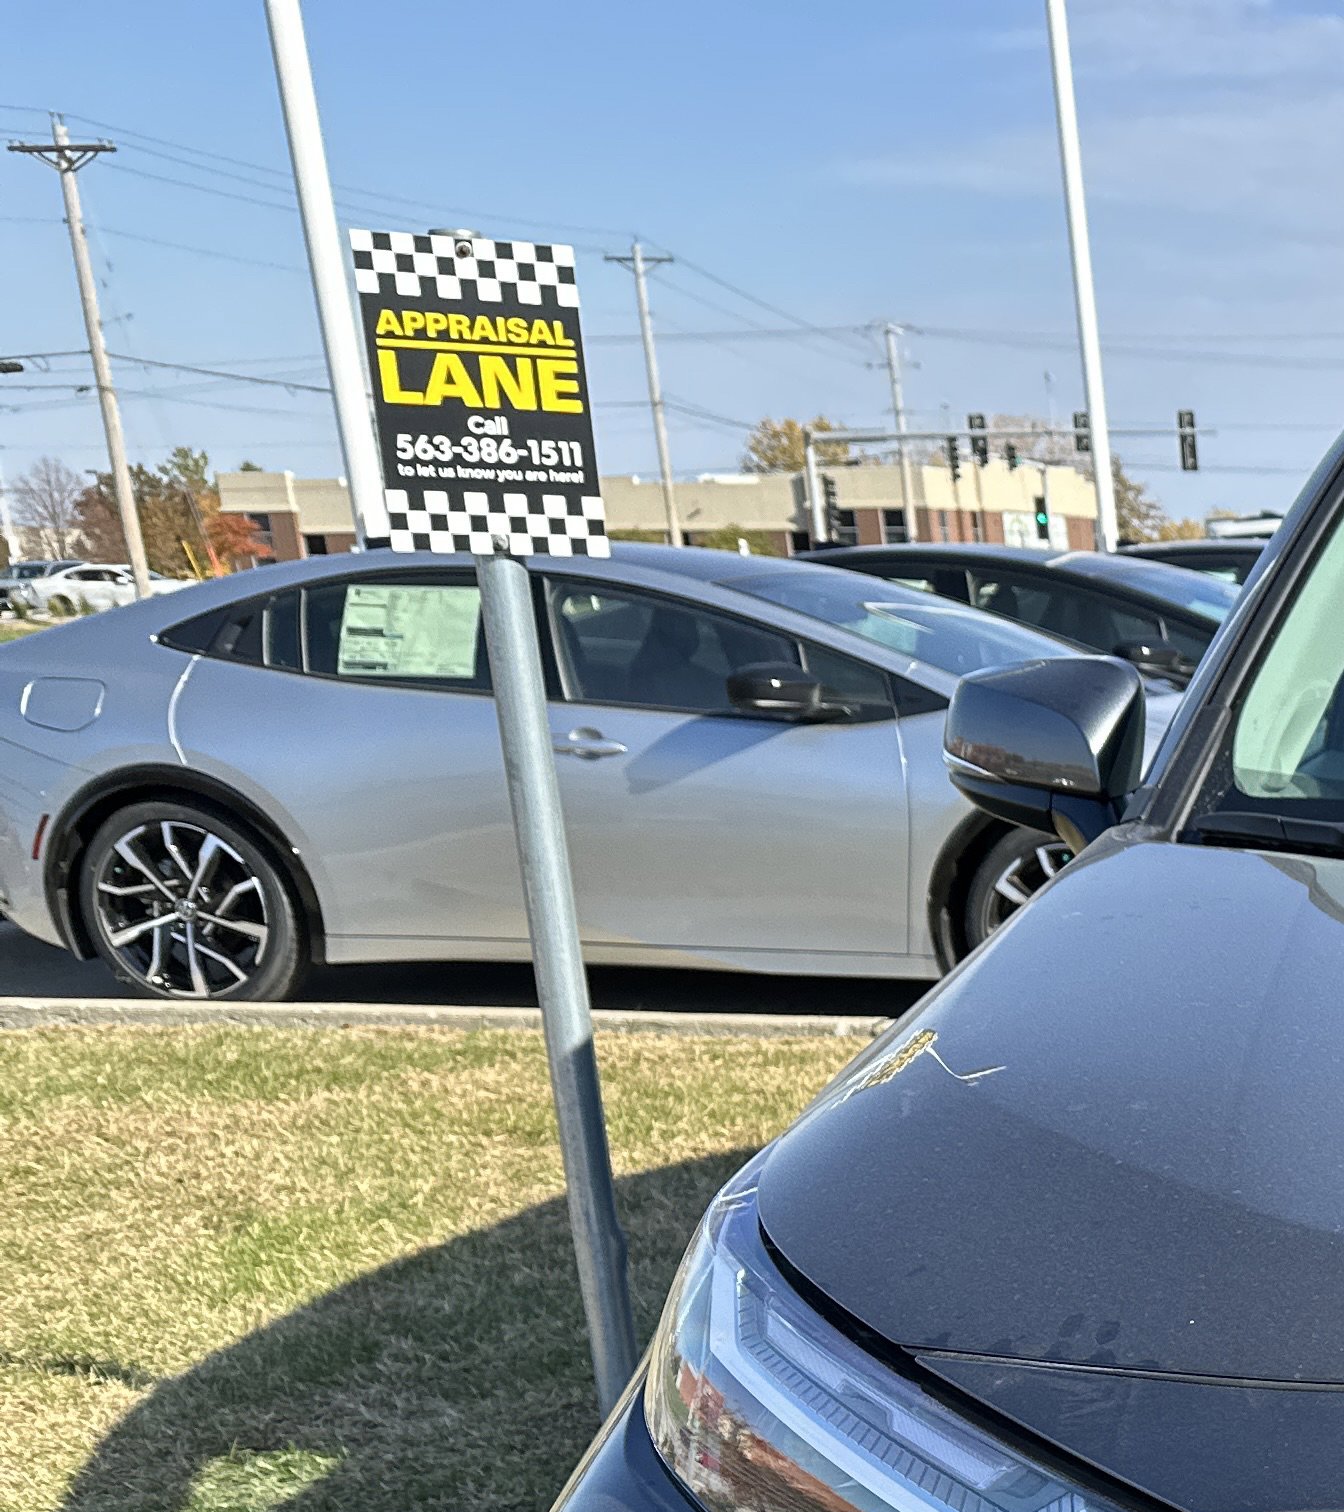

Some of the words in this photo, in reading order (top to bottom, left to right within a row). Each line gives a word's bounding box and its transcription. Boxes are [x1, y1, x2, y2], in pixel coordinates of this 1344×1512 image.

[375, 308, 576, 348] APPRAISAL
[377, 349, 584, 414] LANE
[467, 415, 509, 436] Call
[396, 433, 584, 468] 563-386-1511
[397, 463, 416, 477] to
[416, 463, 437, 478] let
[437, 467, 456, 479] us
[456, 464, 496, 480] know
[496, 468, 524, 483] you
[524, 469, 549, 482] are
[549, 468, 585, 484] here!
